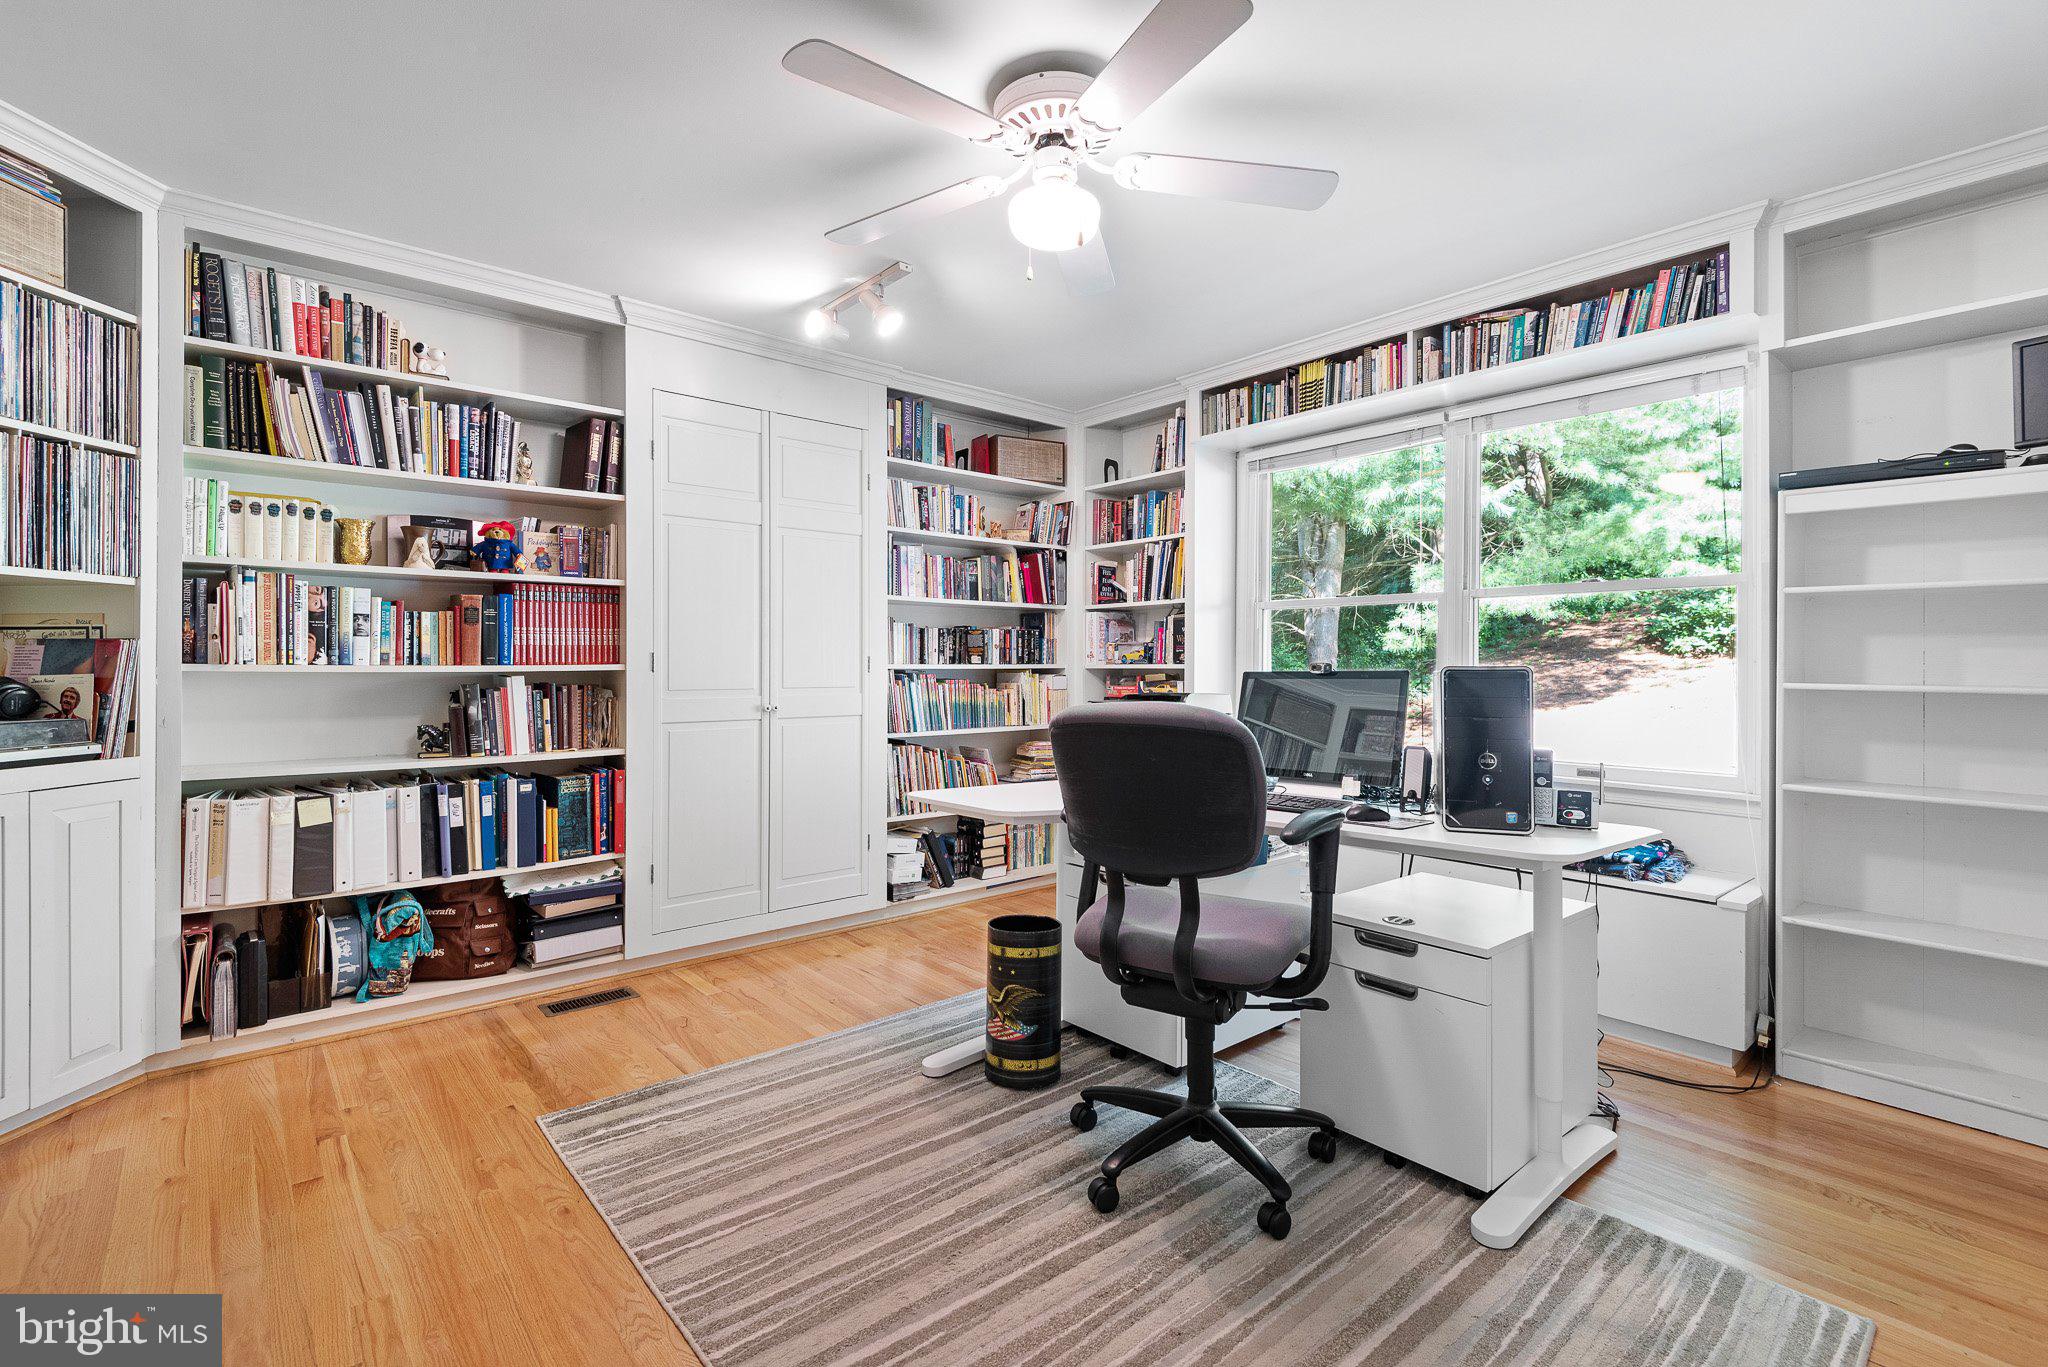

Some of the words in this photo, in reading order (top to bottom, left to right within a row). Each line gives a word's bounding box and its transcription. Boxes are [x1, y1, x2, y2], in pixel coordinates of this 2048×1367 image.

[206, 258, 221, 304] ROGET'S
[295, 282, 303, 300] Zorro
[231, 276, 245, 333] DICTIONARY
[527, 538, 561, 547] Paddington
[183, 579, 193, 602] DANIELLE
[183, 602, 192, 616] STEEL
[198, 594, 206, 613] Higgins
[183, 633, 192, 654] MAGIC
[474, 961, 494, 969] Needles
